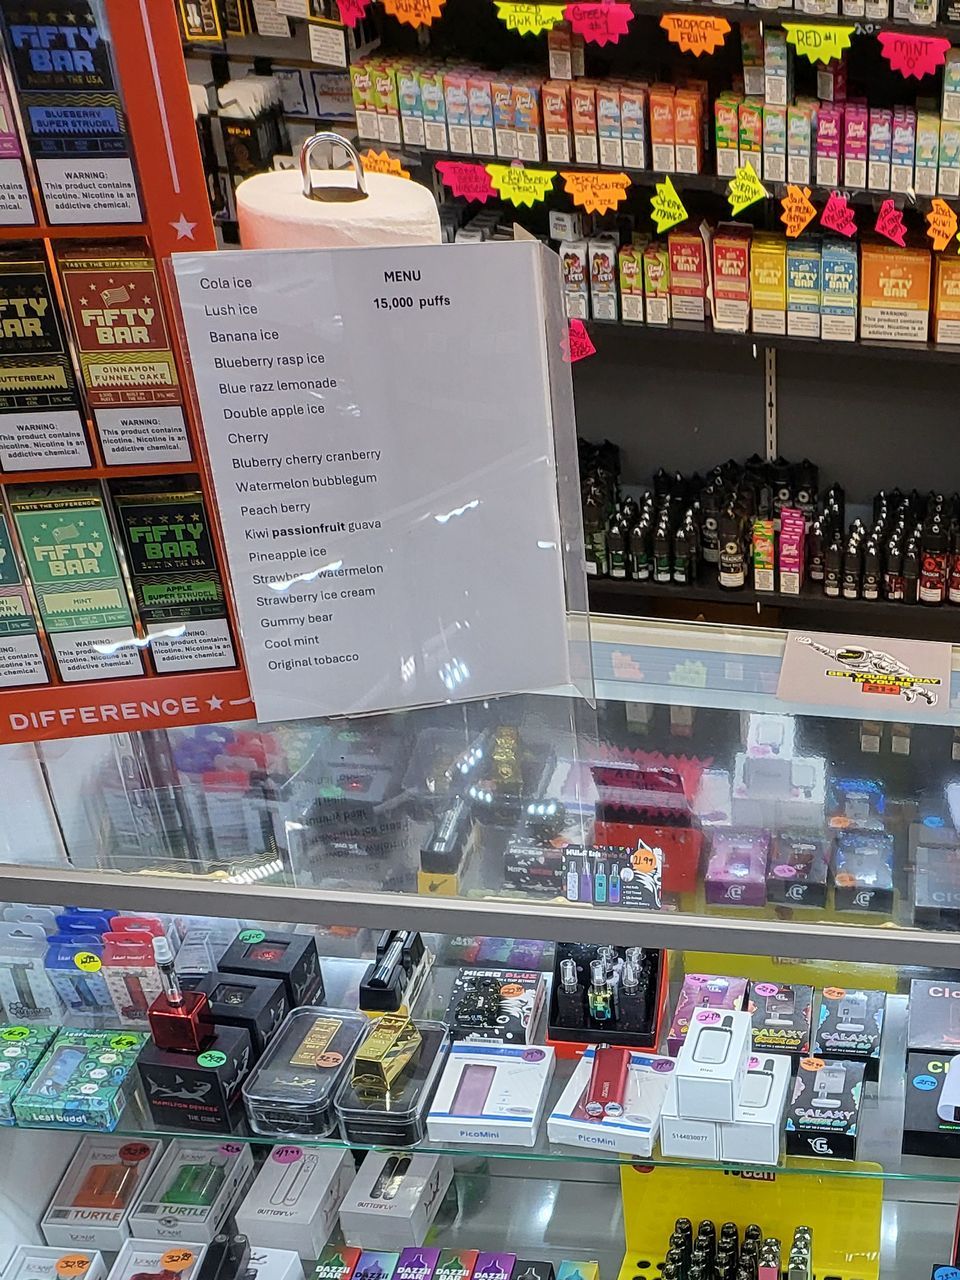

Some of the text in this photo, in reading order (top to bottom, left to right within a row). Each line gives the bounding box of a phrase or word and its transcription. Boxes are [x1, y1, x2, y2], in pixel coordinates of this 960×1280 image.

[670, 18, 721, 32] TROPICAL
[796, 31, 822, 47] RED
[30, 50, 96, 72] BAR
[45, 110, 101, 118] BLUEBERRY
[36, 119, 114, 128] SUPER STRUDEL
[384, 270, 422, 282] MENU
[200, 277, 252, 290] Cola ice
[373, 294, 451, 310] 15,000 puffs
[204, 304, 258, 316] Lush ice
[96, 326, 150, 344] BAR
[210, 329, 280, 342] Banana ice
[214, 353, 325, 369] Blueberry rasp ice
[94, 374, 136, 382] FUNNEL
[219, 378, 338, 394] Blue razz lemonade
[224, 404, 325, 420] Double apple ice
[120, 418, 161, 426] WARNING:
[102, 426, 182, 436] This product contains
[102, 436, 136, 444] nicotine.
[137, 436, 166, 444] Nicotine
[228, 432, 269, 446] Cherry
[111, 444, 146, 452] addictive
[232, 448, 382, 470] Bluberry cherry cranberry
[236, 473, 377, 492] Watermelon bubblegum
[241, 502, 311, 516] Peach berry
[244, 520, 382, 540] Kiwi passionfruit guava
[144, 541, 199, 560] BAR
[248, 546, 328, 562] Pineapple ice
[48, 560, 100, 576] BAR
[318, 564, 384, 579] watermelon
[148, 590, 215, 600] SUPER STRUDEL
[256, 587, 376, 607] Strawberry ice cream
[260, 612, 334, 629] Gummy bear
[264, 635, 320, 650] Cool mint
[268, 652, 360, 671] Original tobacco
[899, 676, 938, 684] TODAY
[9, 696, 200, 731] DIFFERENCE
[33, 1112, 56, 1123] Leaf
[794, 1107, 855, 1120] GALAXY
[460, 1130, 500, 1140] PicoMini
[578, 1134, 616, 1147] PicoMini
[74, 1210, 121, 1221] TURTLE
[318, 1272, 341, 1280] BAR
